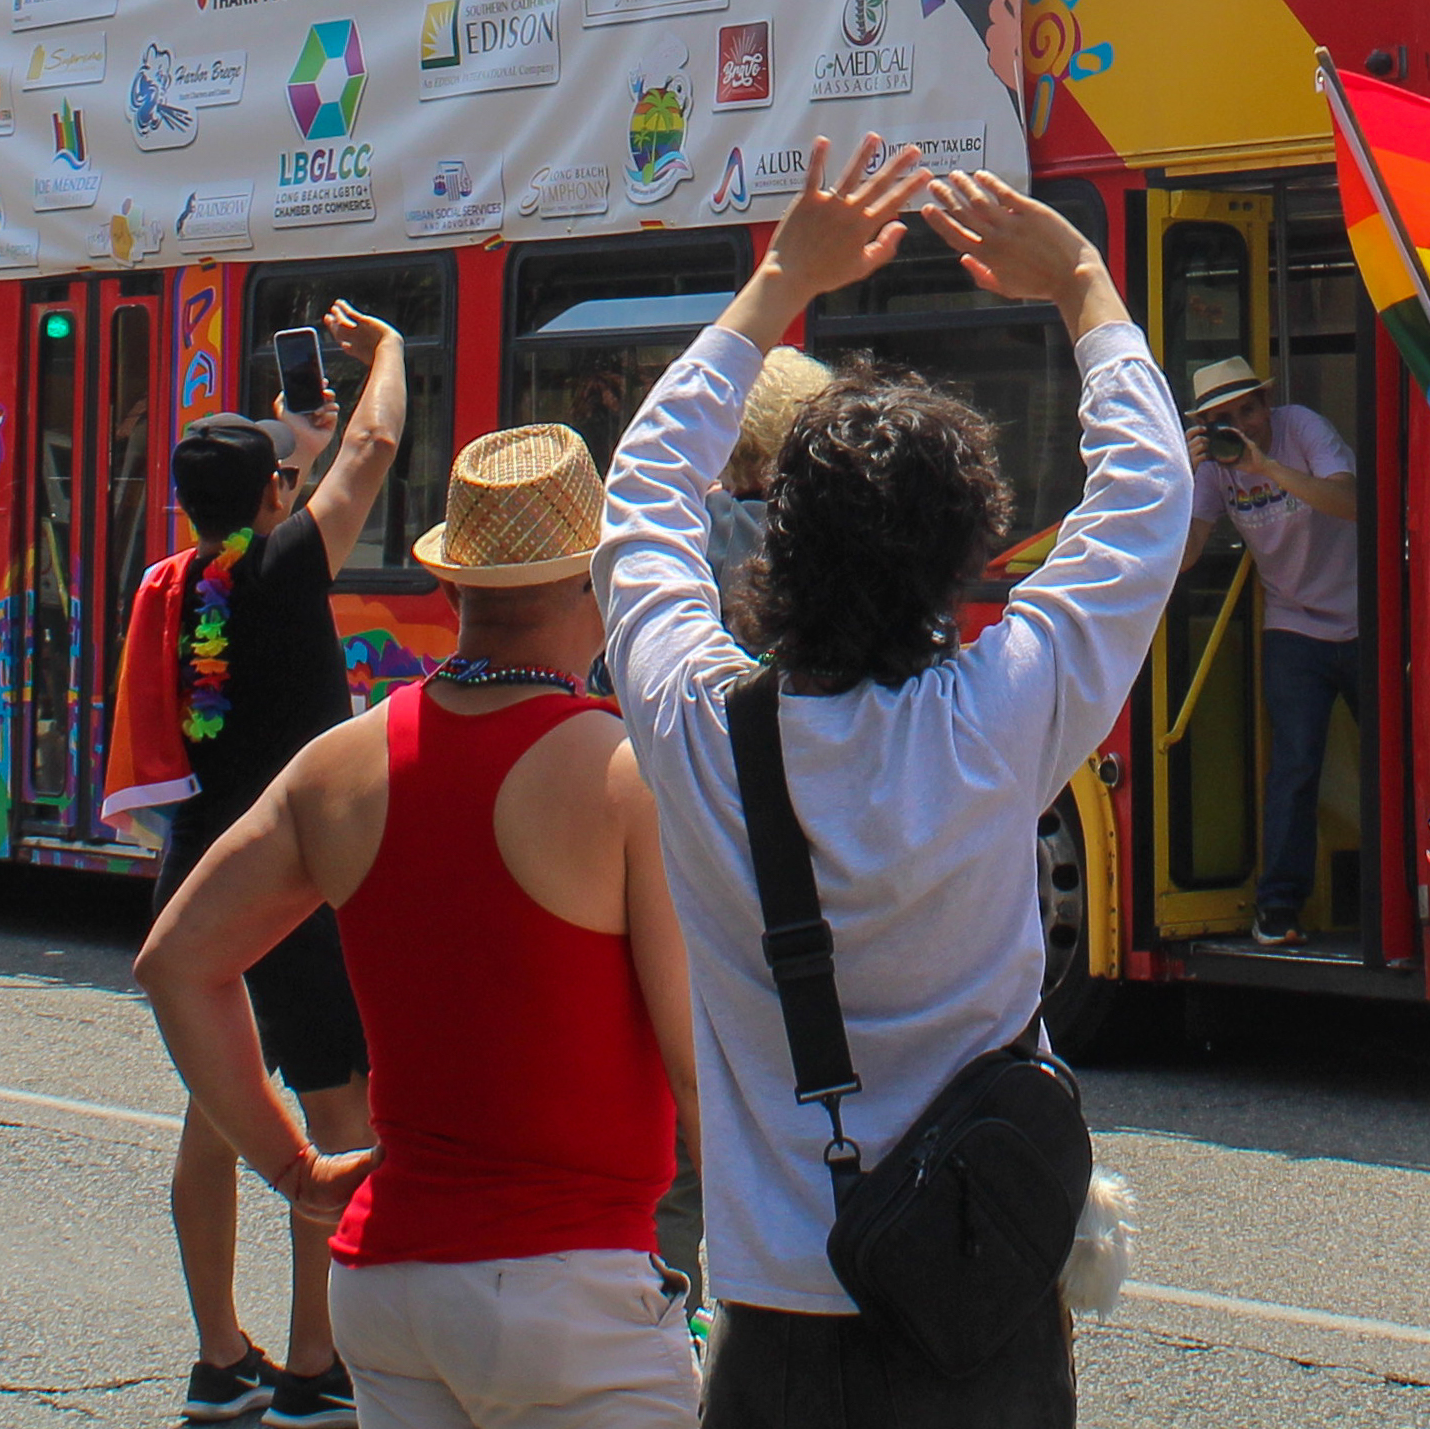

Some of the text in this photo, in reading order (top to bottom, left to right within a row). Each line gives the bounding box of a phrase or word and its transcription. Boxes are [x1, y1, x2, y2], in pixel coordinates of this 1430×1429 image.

[466, 0, 508, 17] SOUTHERN
[466, 10, 554, 54] EDISON
[175, 60, 242, 85] Harbor Breeze
[519, 63, 554, 77] Company
[812, 73, 908, 95] MASSAGE SPA
[942, 139, 958, 153] TAX
[960, 137, 982, 152] LBC
[278, 143, 371, 188] LBGLCC
[754, 149, 811, 176] ALUR
[549, 166, 605, 183] LONG BEACH
[34, 178, 51, 196] JOE
[275, 185, 369, 205] LONG BEACH LGBTQ+
[521, 167, 606, 210] SYMPHONY
[195, 198, 249, 219] RAINBOW
[274, 199, 372, 219] CHAMBER OF COMMERCE
[435, 206, 461, 220] SOCIAL
[462, 202, 502, 218] SERVICES
[423, 220, 441, 230] AND
